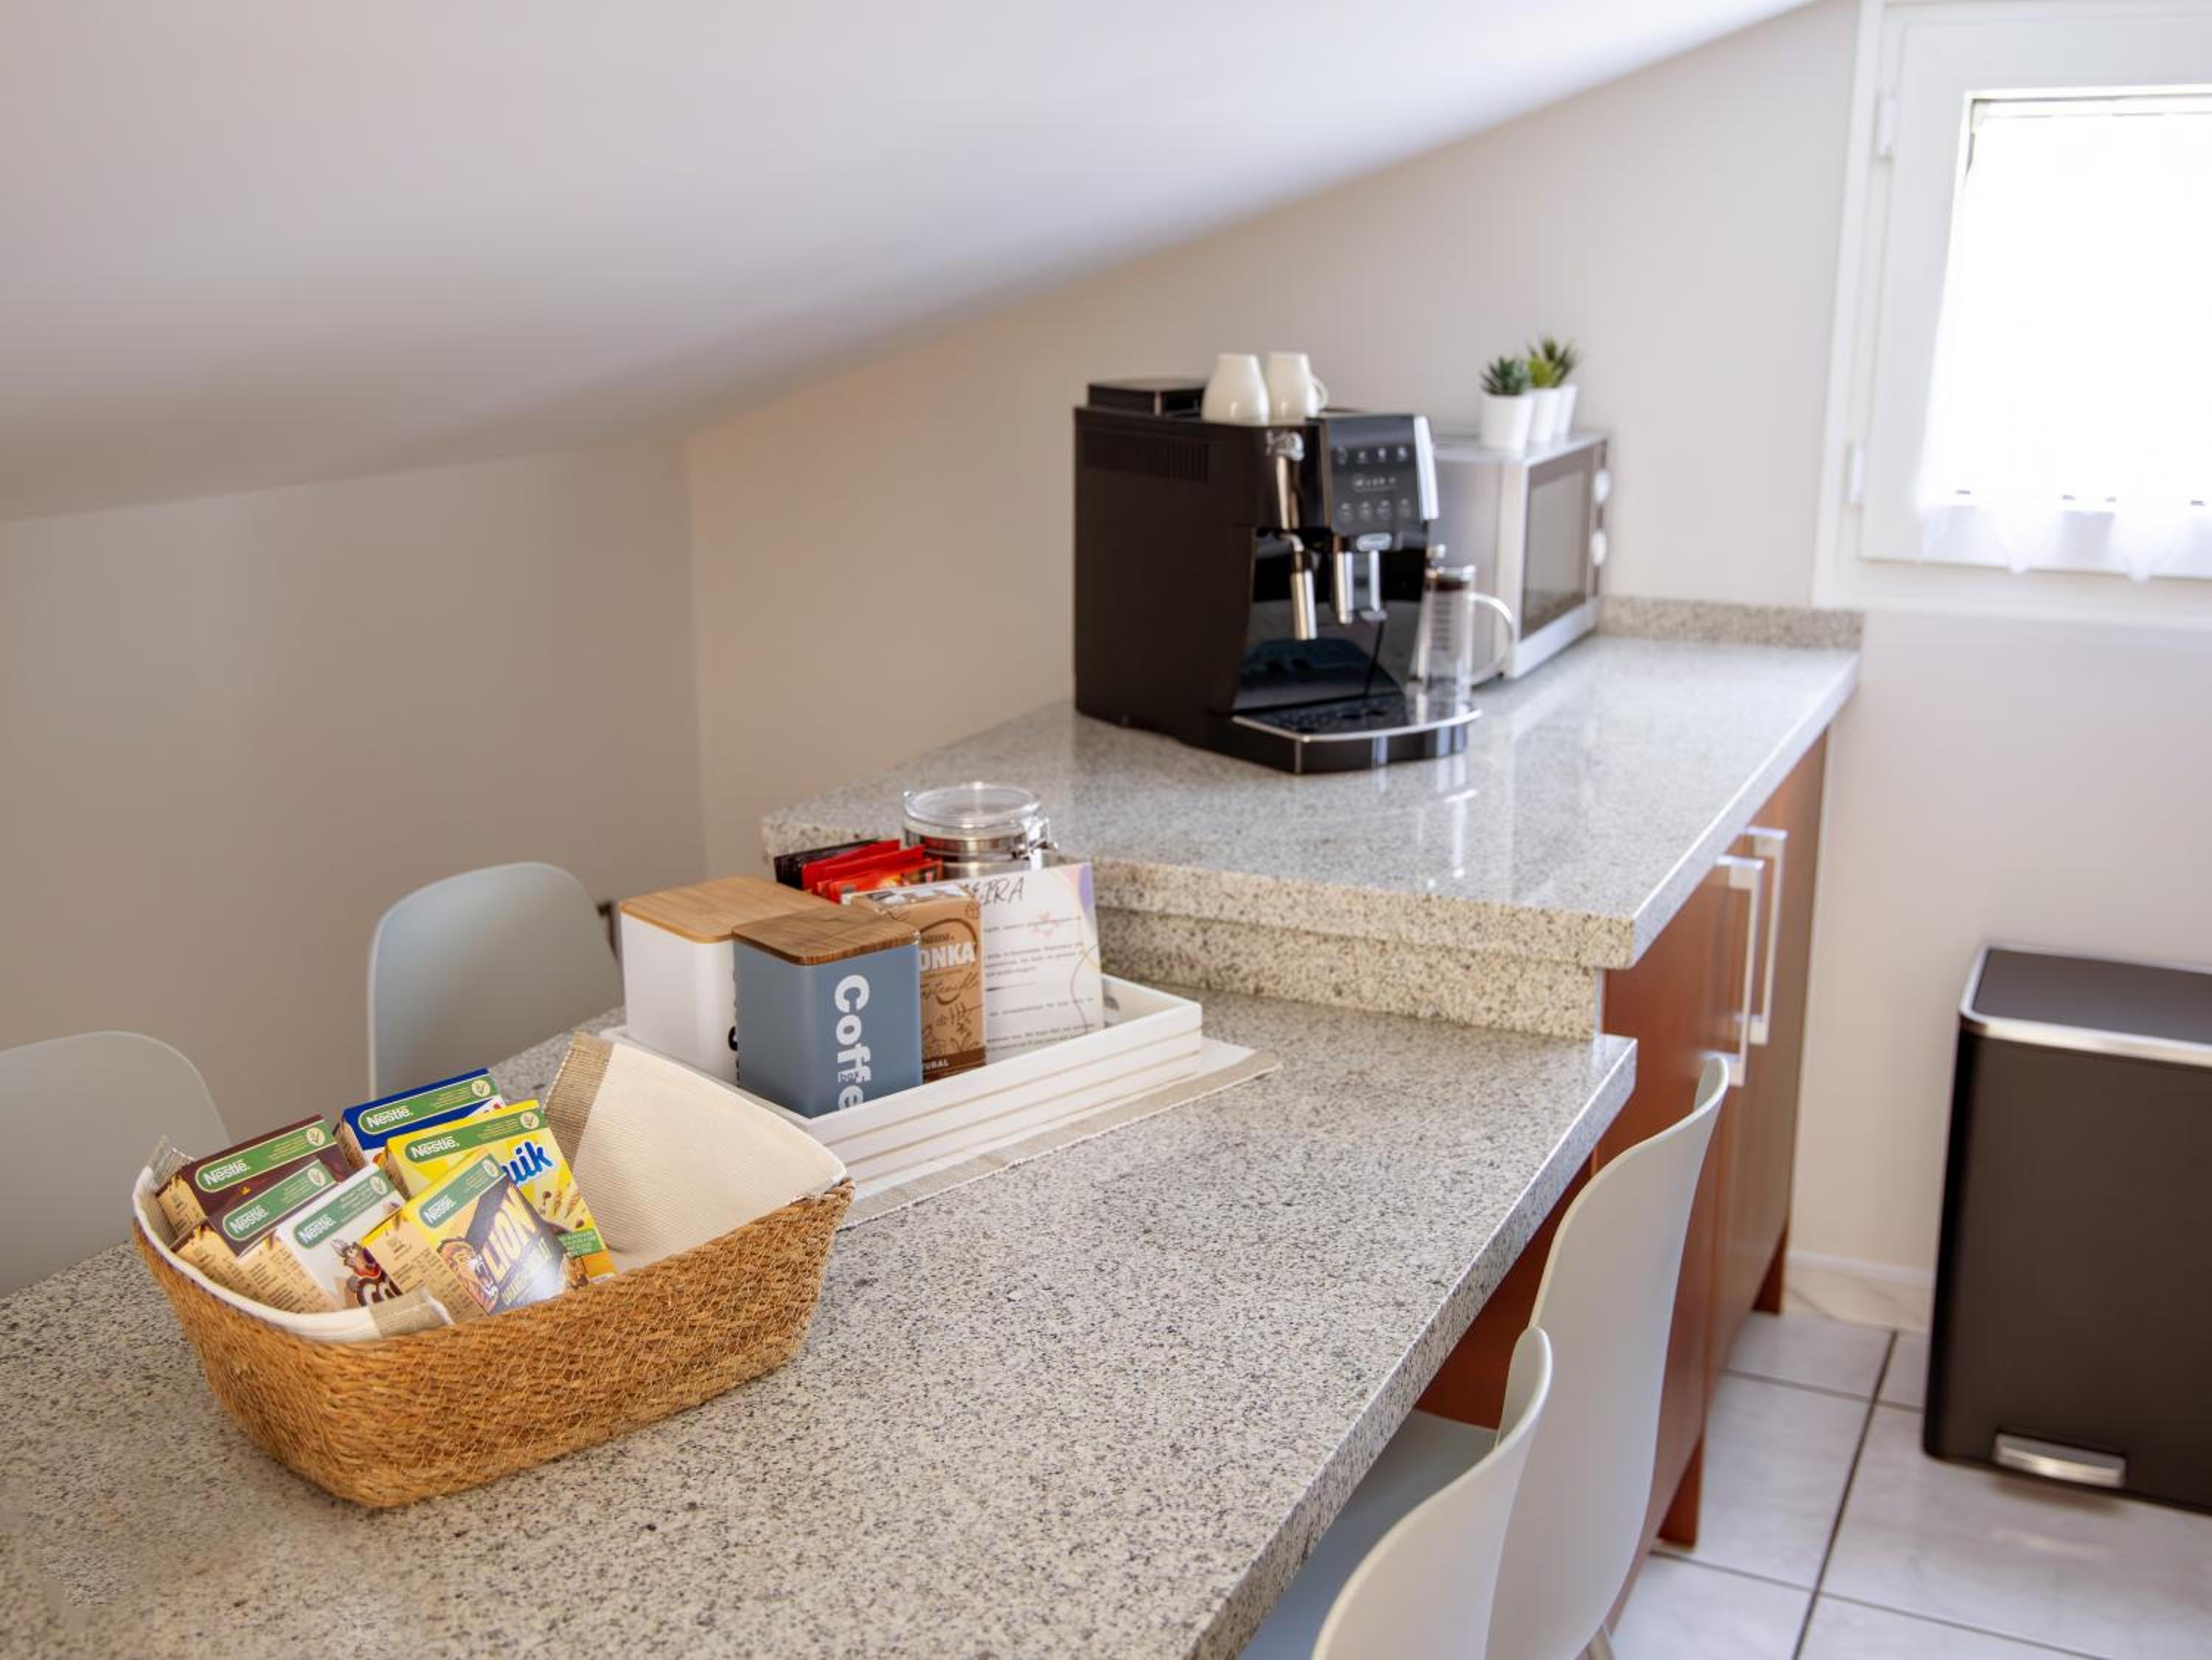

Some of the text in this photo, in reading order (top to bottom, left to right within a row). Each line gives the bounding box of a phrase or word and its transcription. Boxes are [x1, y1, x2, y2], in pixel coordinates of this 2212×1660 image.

[920, 941, 976, 972] ONKA
[834, 974, 872, 1109] Coffe
[501, 1140, 554, 1185] uik
[481, 1183, 538, 1284] LION
